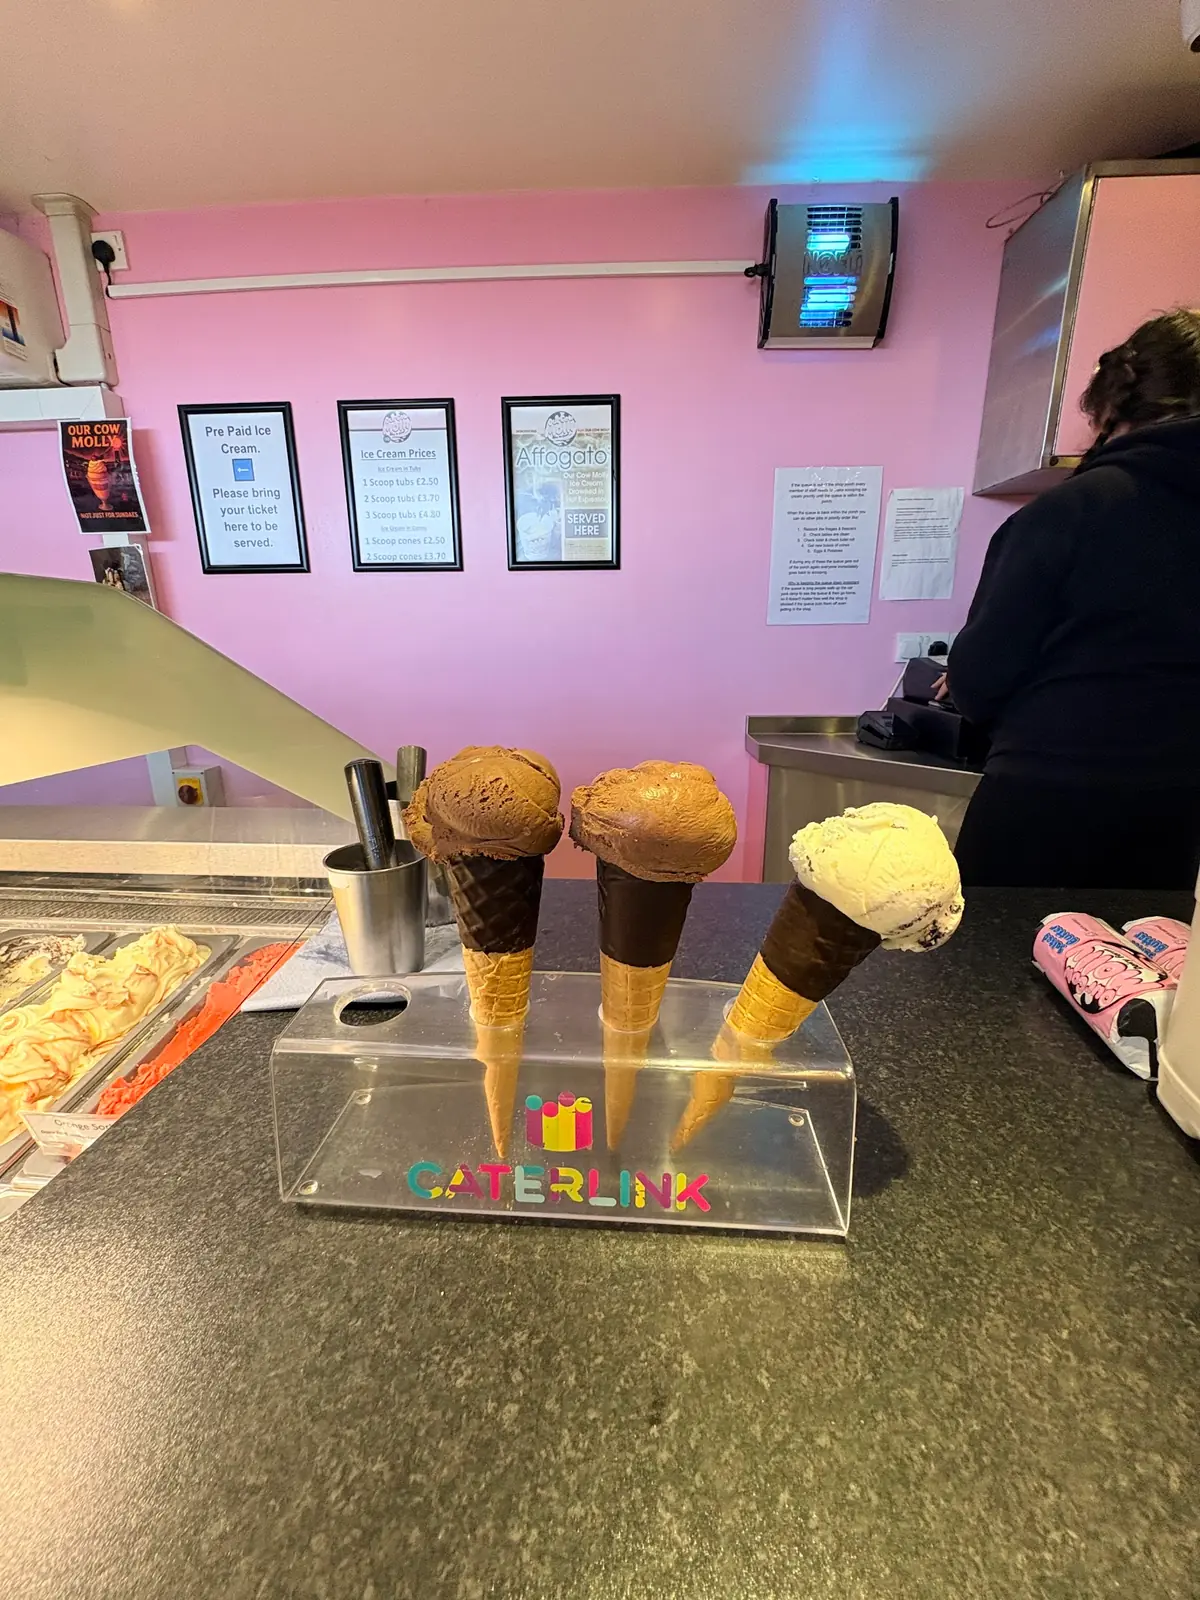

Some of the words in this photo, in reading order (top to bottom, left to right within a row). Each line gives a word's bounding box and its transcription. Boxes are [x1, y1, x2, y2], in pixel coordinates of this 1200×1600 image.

[68, 425, 90, 435] OUR
[94, 424, 120, 434] COW
[205, 426, 224, 436] Pre
[227, 426, 252, 436] Paid
[255, 425, 271, 435] Ice
[72, 435, 116, 448] MOLLY
[221, 444, 260, 454] Cream.
[361, 450, 374, 458] Ice
[377, 450, 406, 458] Cream
[409, 449, 436, 457] Prices
[517, 446, 607, 469] Affogato
[370, 479, 394, 487] Scoop
[212, 488, 248, 498] Please
[252, 488, 280, 499] bring
[371, 495, 395, 504] Scoop
[220, 507, 244, 517] your
[248, 505, 278, 514] ticket
[373, 511, 397, 520] Scoop
[567, 514, 605, 523] SERVED
[224, 522, 248, 531] here
[251, 522, 262, 530] to
[265, 521, 278, 530] be
[574, 525, 600, 535] HERE
[234, 538, 273, 547] served.
[372, 537, 396, 546] Scoop
[1050, 925, 1080, 947] Butter
[1134, 931, 1169, 953] Butter
[406, 1160, 711, 1212] CATERLINK
